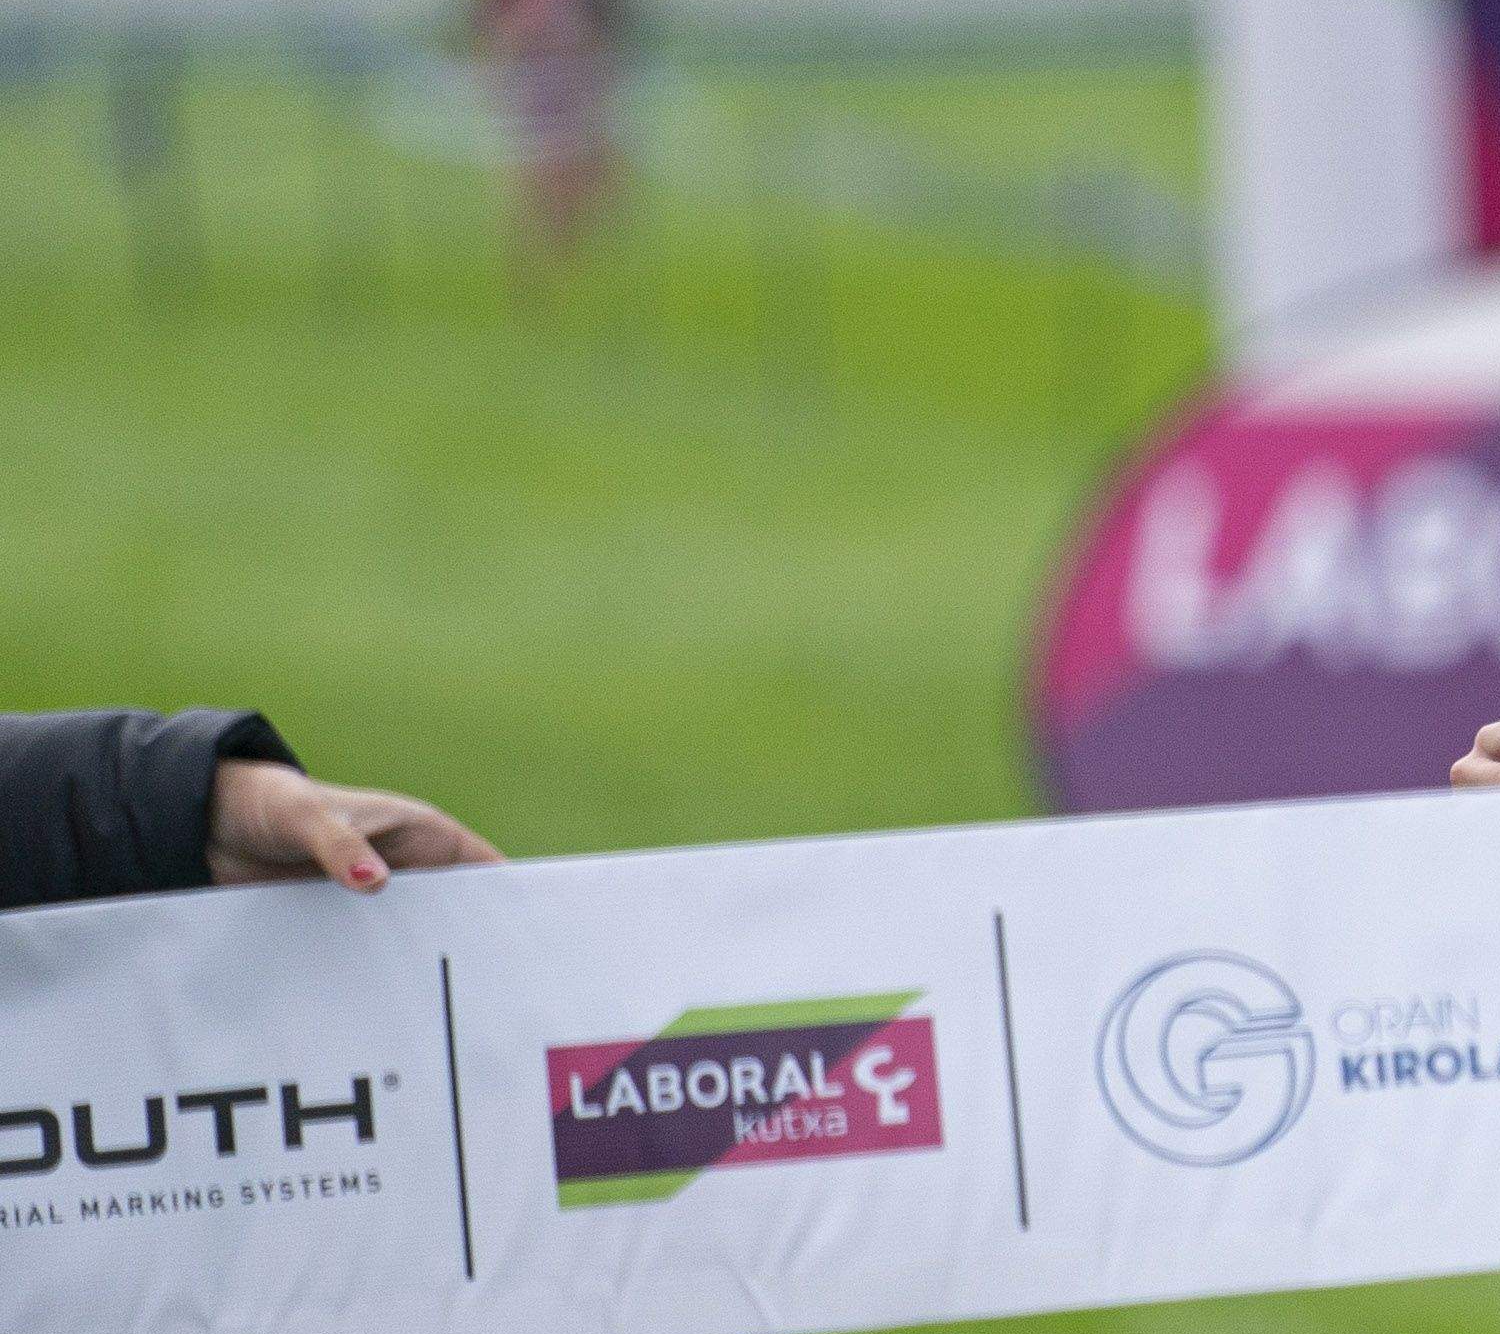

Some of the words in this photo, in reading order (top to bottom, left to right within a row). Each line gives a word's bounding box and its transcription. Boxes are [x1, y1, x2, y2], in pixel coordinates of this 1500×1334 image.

[569, 1051, 846, 1120] LABORAL
[735, 1101, 850, 1146] kutxa
[79, 1184, 226, 1221] MARKING
[240, 1169, 383, 1206] SYSTEMS
